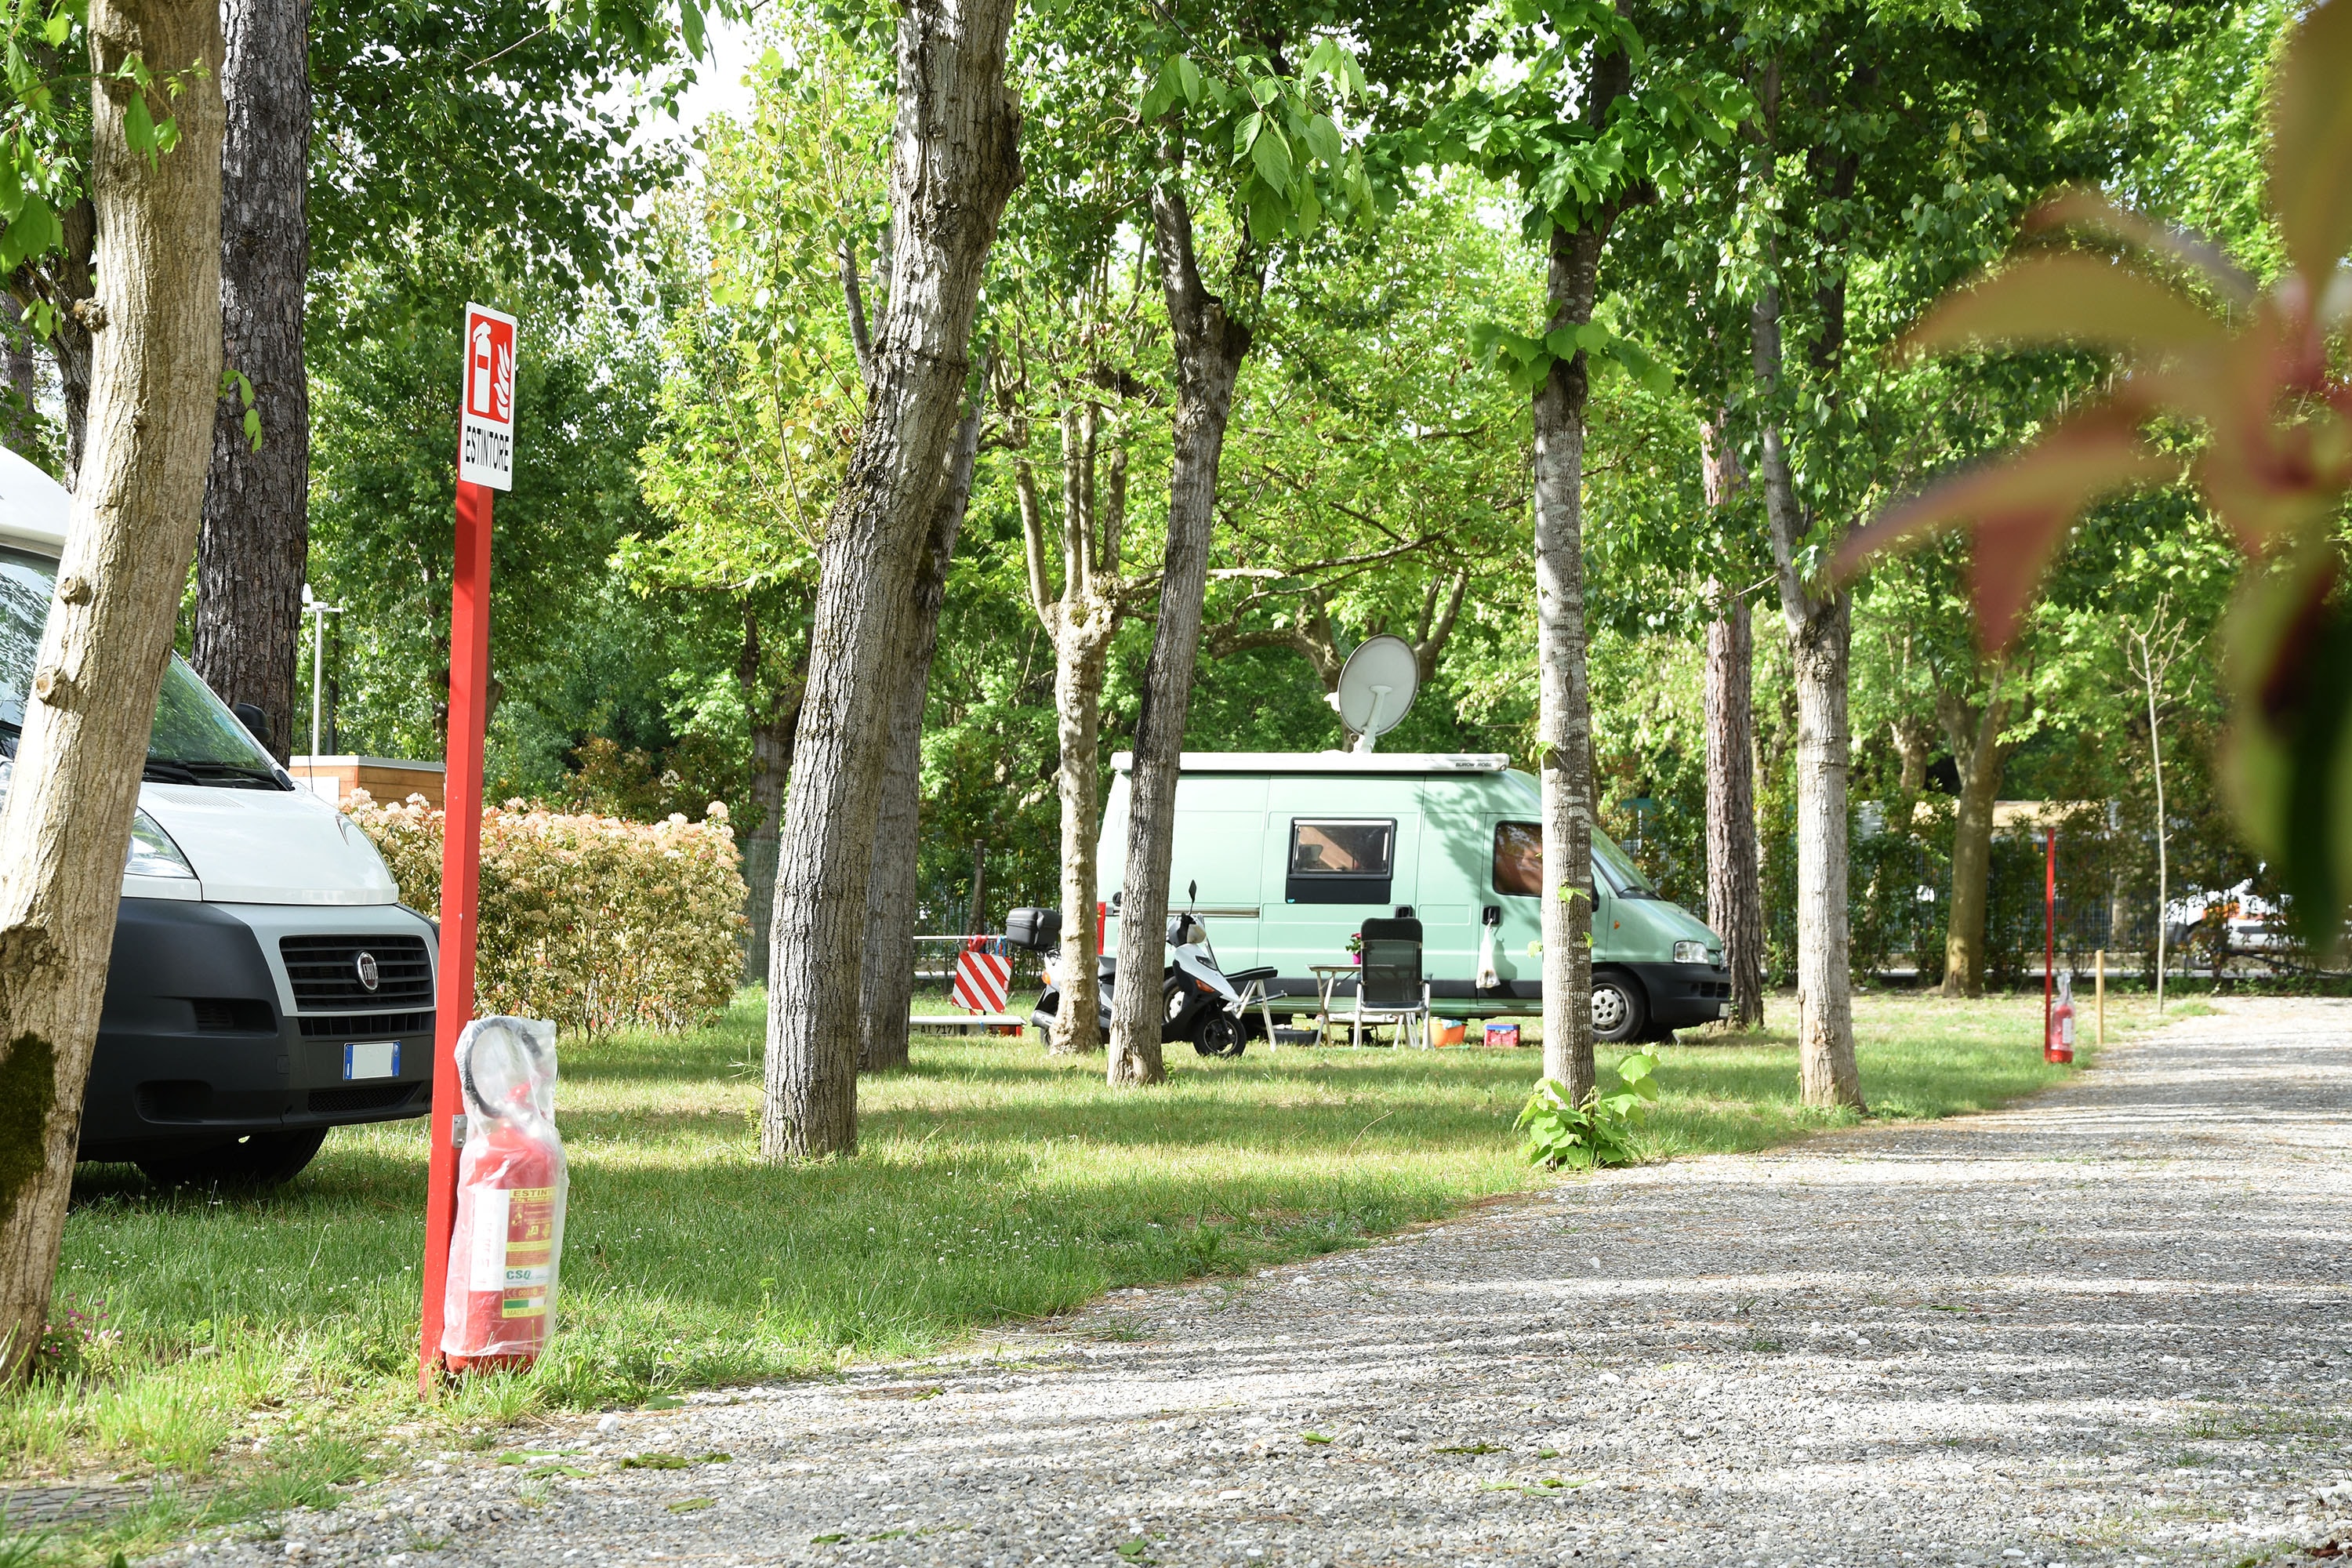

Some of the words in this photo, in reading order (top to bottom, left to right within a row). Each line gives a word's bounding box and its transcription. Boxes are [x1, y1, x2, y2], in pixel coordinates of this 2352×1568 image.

[466, 425, 509, 472] ESTINTORE
[363, 964, 376, 980] FIAT
[935, 1025, 953, 1034] 717
[506, 1269, 532, 1279] CSQ
